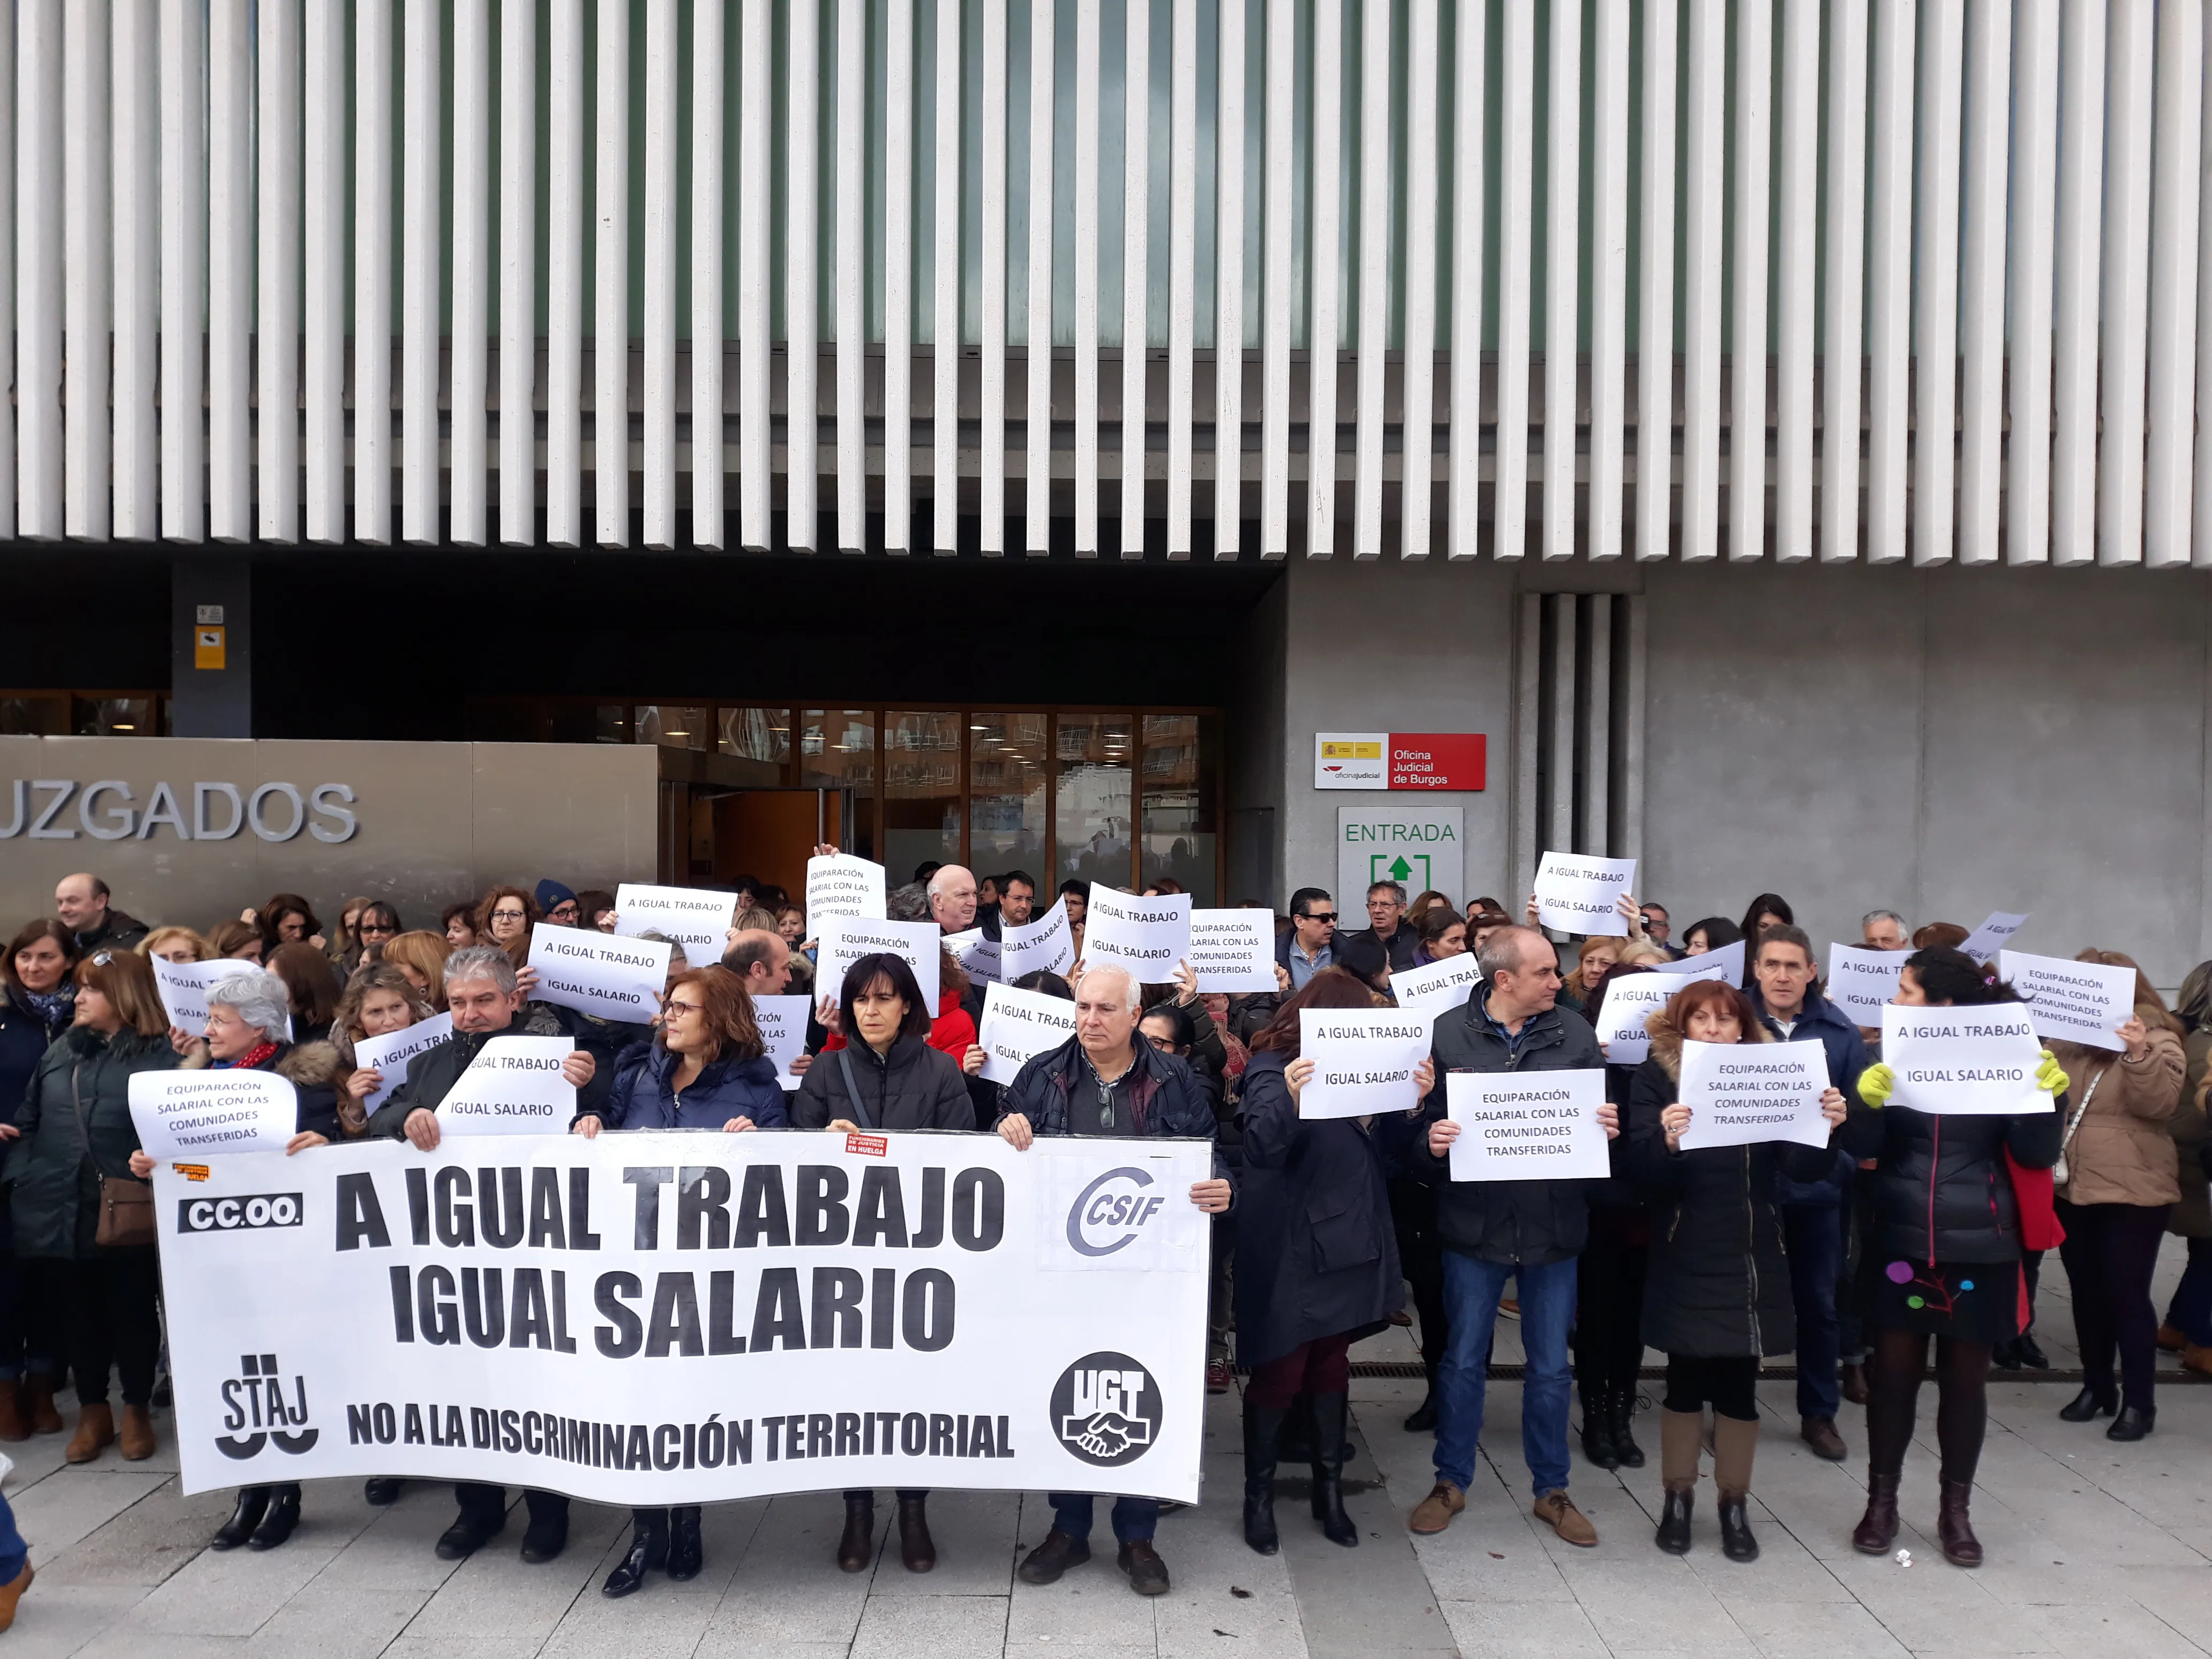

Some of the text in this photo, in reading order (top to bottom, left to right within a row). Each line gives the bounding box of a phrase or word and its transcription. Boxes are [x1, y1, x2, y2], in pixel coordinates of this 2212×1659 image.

[1394, 750, 1431, 760] Oficina
[1394, 763, 1433, 772] Judicial
[1394, 775, 1447, 786] de Burgos
[1346, 824, 1456, 841] ENTRADA
[811, 869, 863, 880] EQUIPARACIÓN
[1556, 868, 1579, 877] IGUAL
[1582, 870, 1624, 882] TRABAJO
[809, 883, 831, 895] SALARIAL
[639, 899, 670, 908] IGUAL
[675, 901, 722, 911] TRABAJO
[811, 896, 862, 907] COMUNIDADES
[1545, 898, 1613, 913] IGUAL SALARIO
[1094, 901, 1178, 922] A IGUAL TRABAJO
[1004, 942, 1030, 951] IGUAL
[1031, 915, 1063, 946] TRABAJO
[842, 934, 909, 948] EQUIPARACIÓN
[544, 943, 655, 967] A IGUAL TRABAJO
[976, 948, 998, 959] IGUAL
[1093, 939, 1170, 959] IGUAL SALARIO
[905, 956, 916, 965] AS
[1842, 961, 1850, 970] A
[1854, 963, 1890, 974] IGUAL
[161, 972, 168, 982] A
[169, 976, 205, 990] IGUAL
[1407, 969, 1481, 998] A IGUAL TRAB
[2029, 970, 2103, 989] EQUIPARACIÓN
[548, 980, 640, 1004] IGUAL SALARIO
[1613, 993, 1619, 1002] A
[1623, 991, 1659, 1002] IGUAL
[2023, 982, 2110, 1005] SALARIAL CON LAS
[1848, 995, 1884, 1006] IGUAL
[992, 1003, 1077, 1031] A IGUAL TRABA
[2032, 1009, 2102, 1029] TRANSFERIDAS
[1317, 1026, 1423, 1038] A IGUAL TRABAJO
[1898, 1023, 2030, 1037] A IGUAL TRABAJO
[372, 1043, 422, 1068] A IGUAL
[996, 1044, 1021, 1062] IGUAL
[469, 1057, 559, 1070] GUAL TRABAJO
[1719, 1062, 1805, 1074] EQUIPARACIÓN
[1325, 1070, 1408, 1085] IGUAL SALARIO
[1908, 1069, 2023, 1082] IGUAL SALARIO
[167, 1082, 261, 1095] EQUIPARACIÓN
[1708, 1081, 1812, 1092] SALARIAL CON LAS
[1483, 1088, 1570, 1104] EQUIPARACIÓN
[1715, 1098, 1800, 1108] COMUNIDADES
[158, 1100, 213, 1115] SALARIAL
[217, 1097, 244, 1106] CON
[451, 1102, 553, 1116] IGUAL SALARIO
[169, 1111, 258, 1131] COMUNIDADES
[1475, 1108, 1580, 1121] SALARIAL CON LAS
[1714, 1114, 1795, 1125] TRANSFERIDAS
[176, 1128, 257, 1146] TRANSFERIDAS
[1484, 1126, 1572, 1139] COMUNIDADES
[858, 1146, 883, 1155] HUELGA
[1486, 1144, 1571, 1156] TRANSFERIDAS
[188, 1195, 300, 1230] CC.OO.
[336, 1164, 1005, 1252] A IGUAL TRABAJO
[389, 1265, 955, 1359] IGUAL SALARIO
[1073, 1369, 1144, 1419] UGT
[346, 1403, 1015, 1471] NO A LA DISCRIMINACIÓN TERRITORIAL
